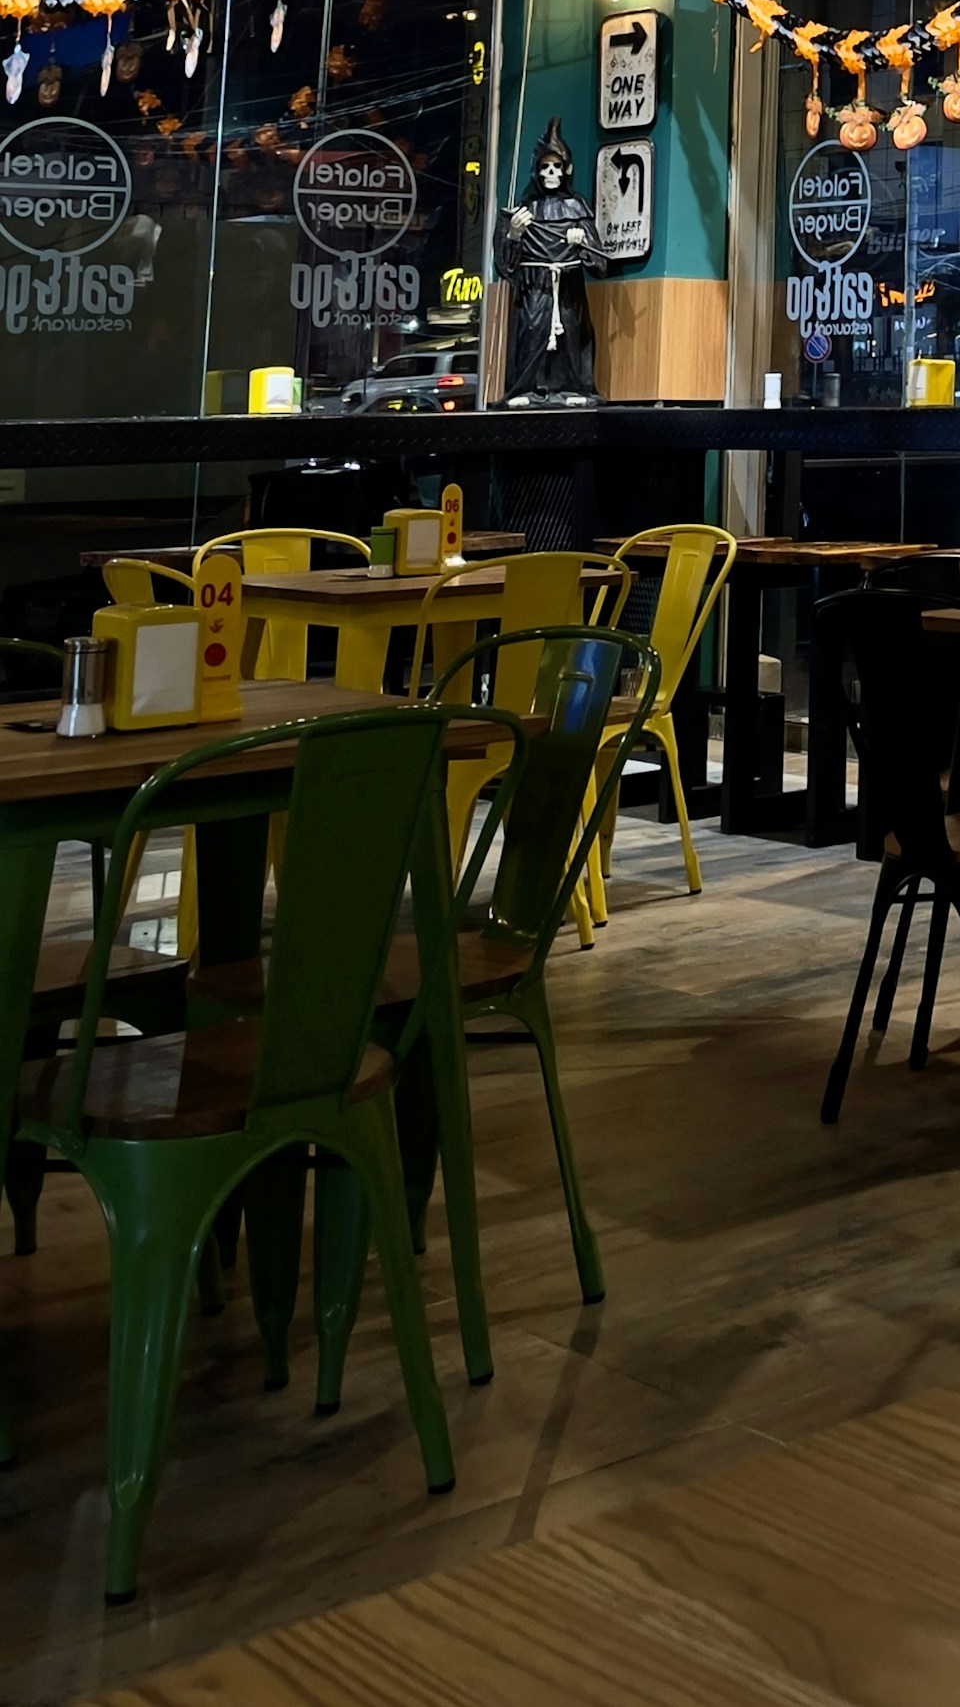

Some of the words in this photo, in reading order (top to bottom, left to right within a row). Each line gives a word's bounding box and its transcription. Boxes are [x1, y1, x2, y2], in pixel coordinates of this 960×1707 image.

[610, 74, 646, 95] ONE
[607, 97, 646, 122] WAY
[445, 499, 460, 513] 06
[200, 582, 234, 608] 04
